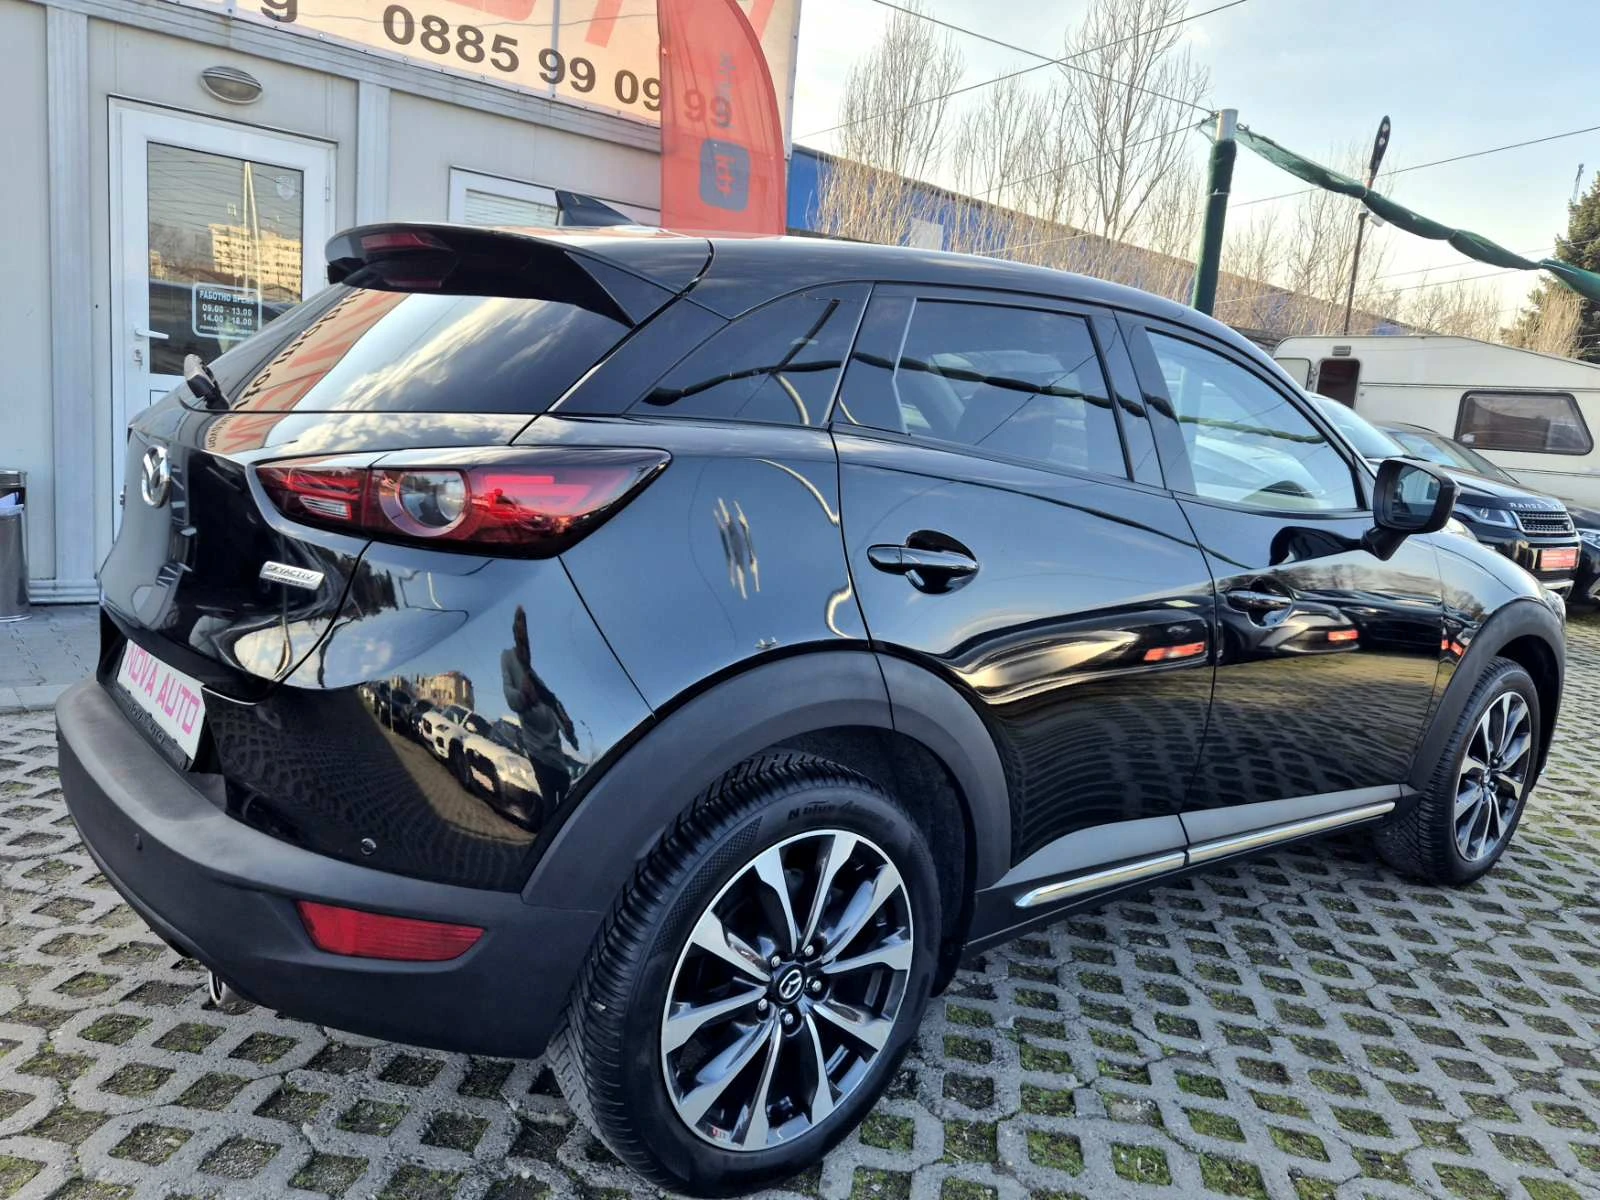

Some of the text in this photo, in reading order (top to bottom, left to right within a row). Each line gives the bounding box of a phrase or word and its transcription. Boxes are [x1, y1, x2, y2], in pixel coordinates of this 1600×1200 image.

[382, 4, 520, 73] 0885
[538, 48, 597, 93] 99
[614, 69, 662, 112] 09
[125, 644, 159, 697] NOVA
[155, 671, 201, 735] AUTO
